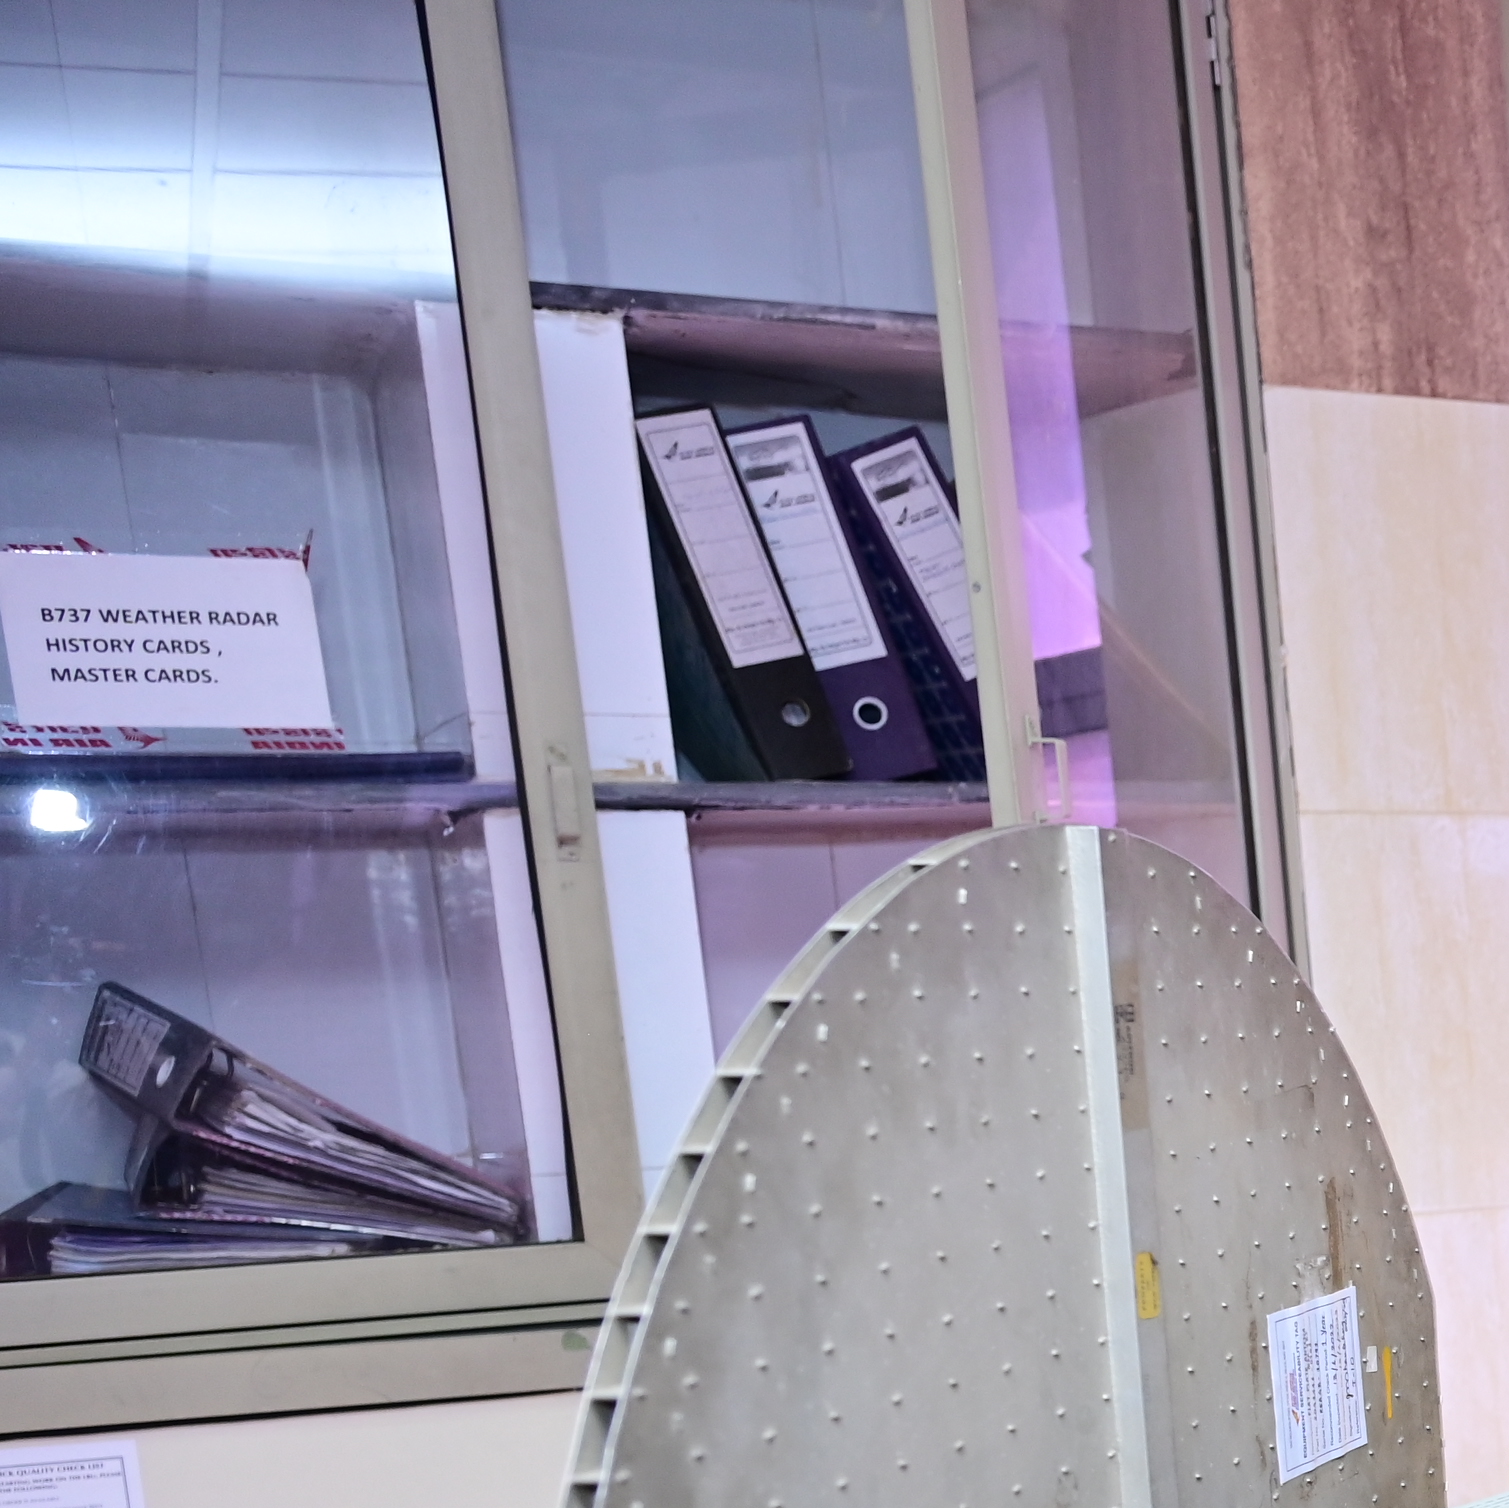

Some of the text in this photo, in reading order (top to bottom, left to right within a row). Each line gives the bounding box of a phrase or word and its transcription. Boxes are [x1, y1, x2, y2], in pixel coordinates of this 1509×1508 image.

[41, 608, 279, 626] B737 WEATHER RADAR
[46, 638, 135, 653] HISTORY
[142, 639, 211, 654] CARDS
[51, 668, 219, 683] MASTER CARDS.
[1294, 1339, 1304, 1408] SERVICEABILITY
[1300, 1410, 1308, 1458] EQUIPMENT
[16, 1467, 54, 1476] QUALITY
